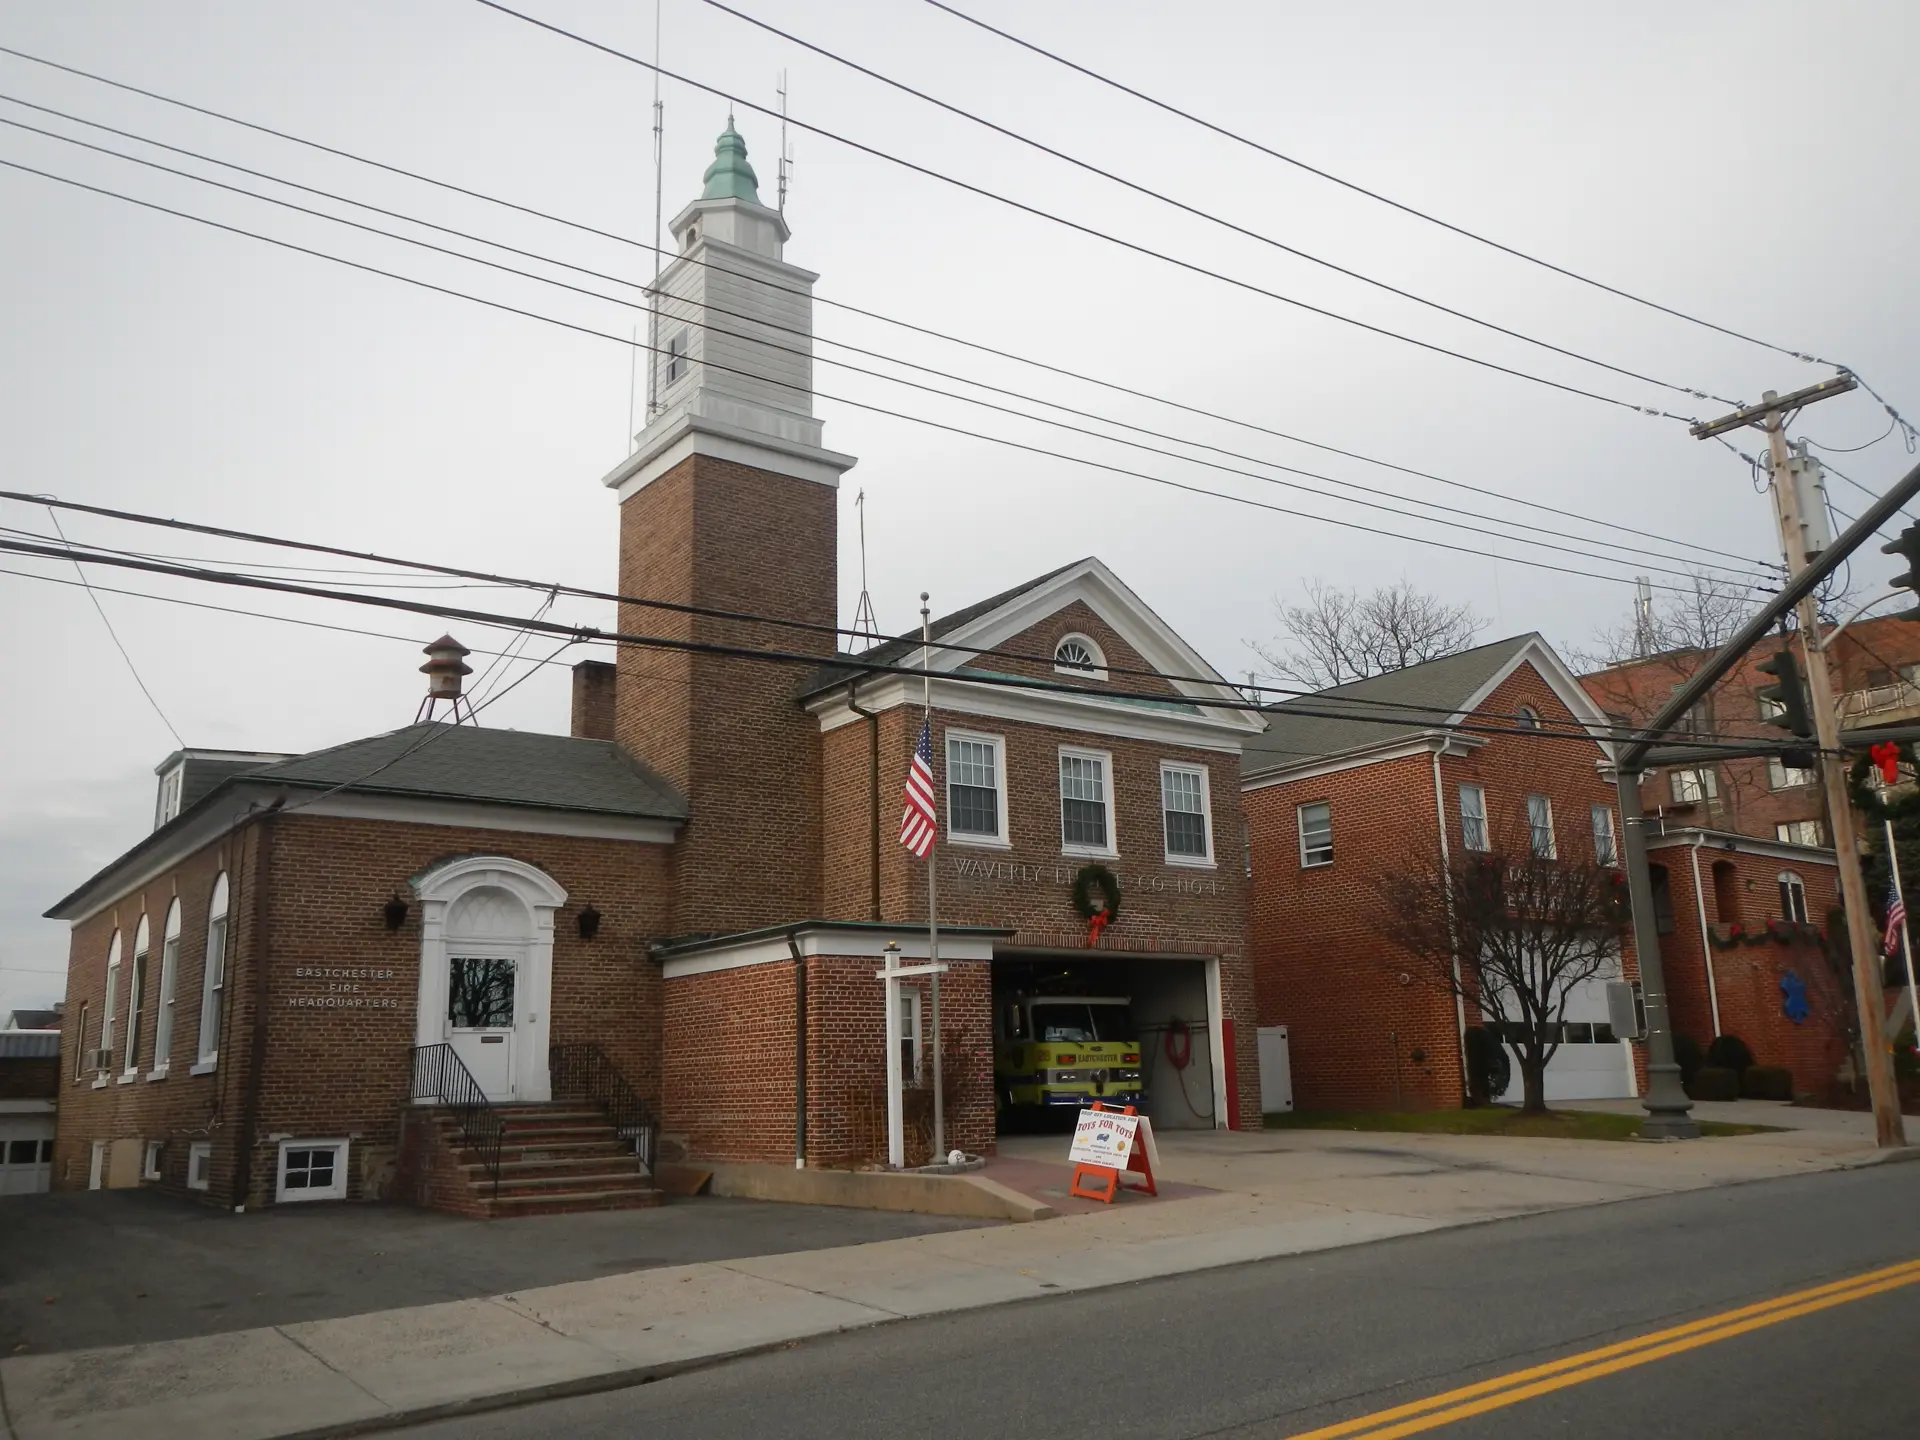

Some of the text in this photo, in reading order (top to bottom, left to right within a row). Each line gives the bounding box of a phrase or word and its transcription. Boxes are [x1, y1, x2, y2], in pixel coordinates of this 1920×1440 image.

[953, 858, 1043, 881] WAVERLY
[1055, 866, 1125, 888] ENE
[296, 968, 394, 979] EASTCHESTER
[329, 984, 360, 993] FIRE
[289, 998, 398, 1008] HEADQUARTERS
[1103, 1113, 1126, 1121] LOCATION
[1077, 1119, 1134, 1139] TOYS FOR TOTS
